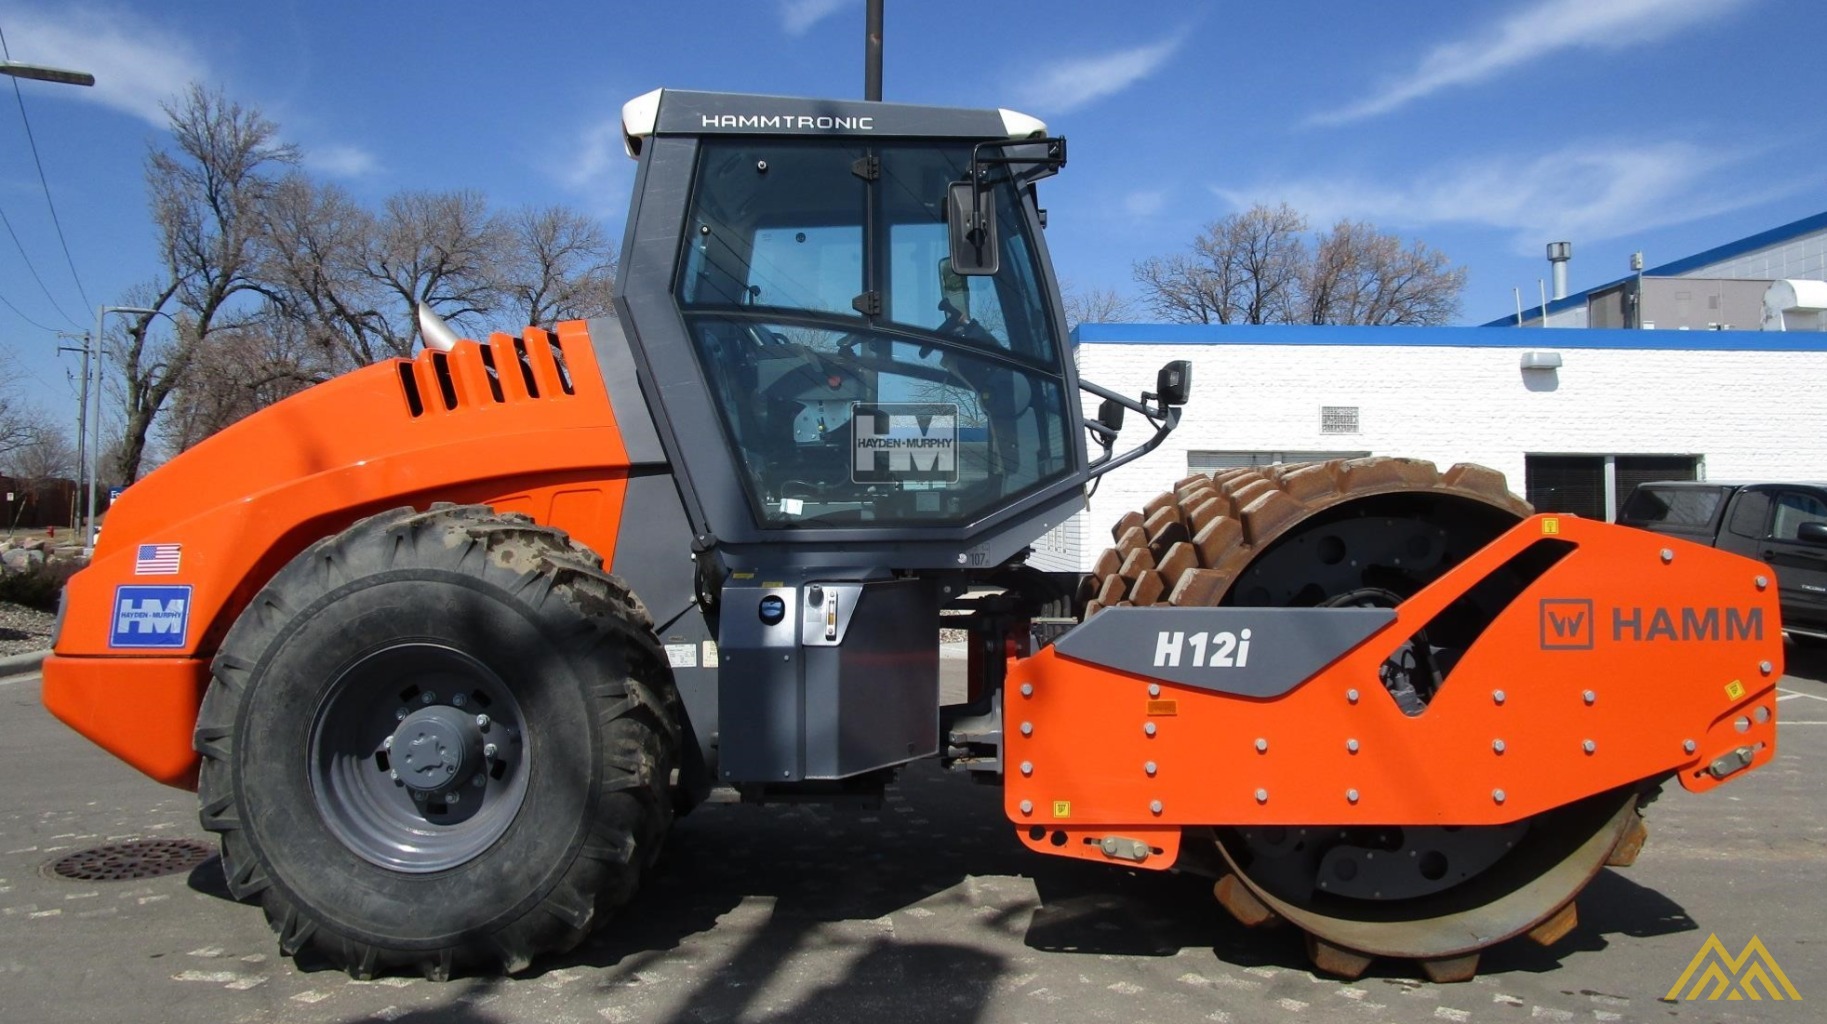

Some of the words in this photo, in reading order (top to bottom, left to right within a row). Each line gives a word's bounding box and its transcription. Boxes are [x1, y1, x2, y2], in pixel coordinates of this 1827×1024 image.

[702, 114, 874, 130] HAMMTRONIC
[856, 415, 954, 471] HM
[970, 552, 986, 566] 107
[117, 599, 185, 634] HM
[1612, 607, 1764, 641] HAMM
[1153, 628, 1252, 668] H12i
